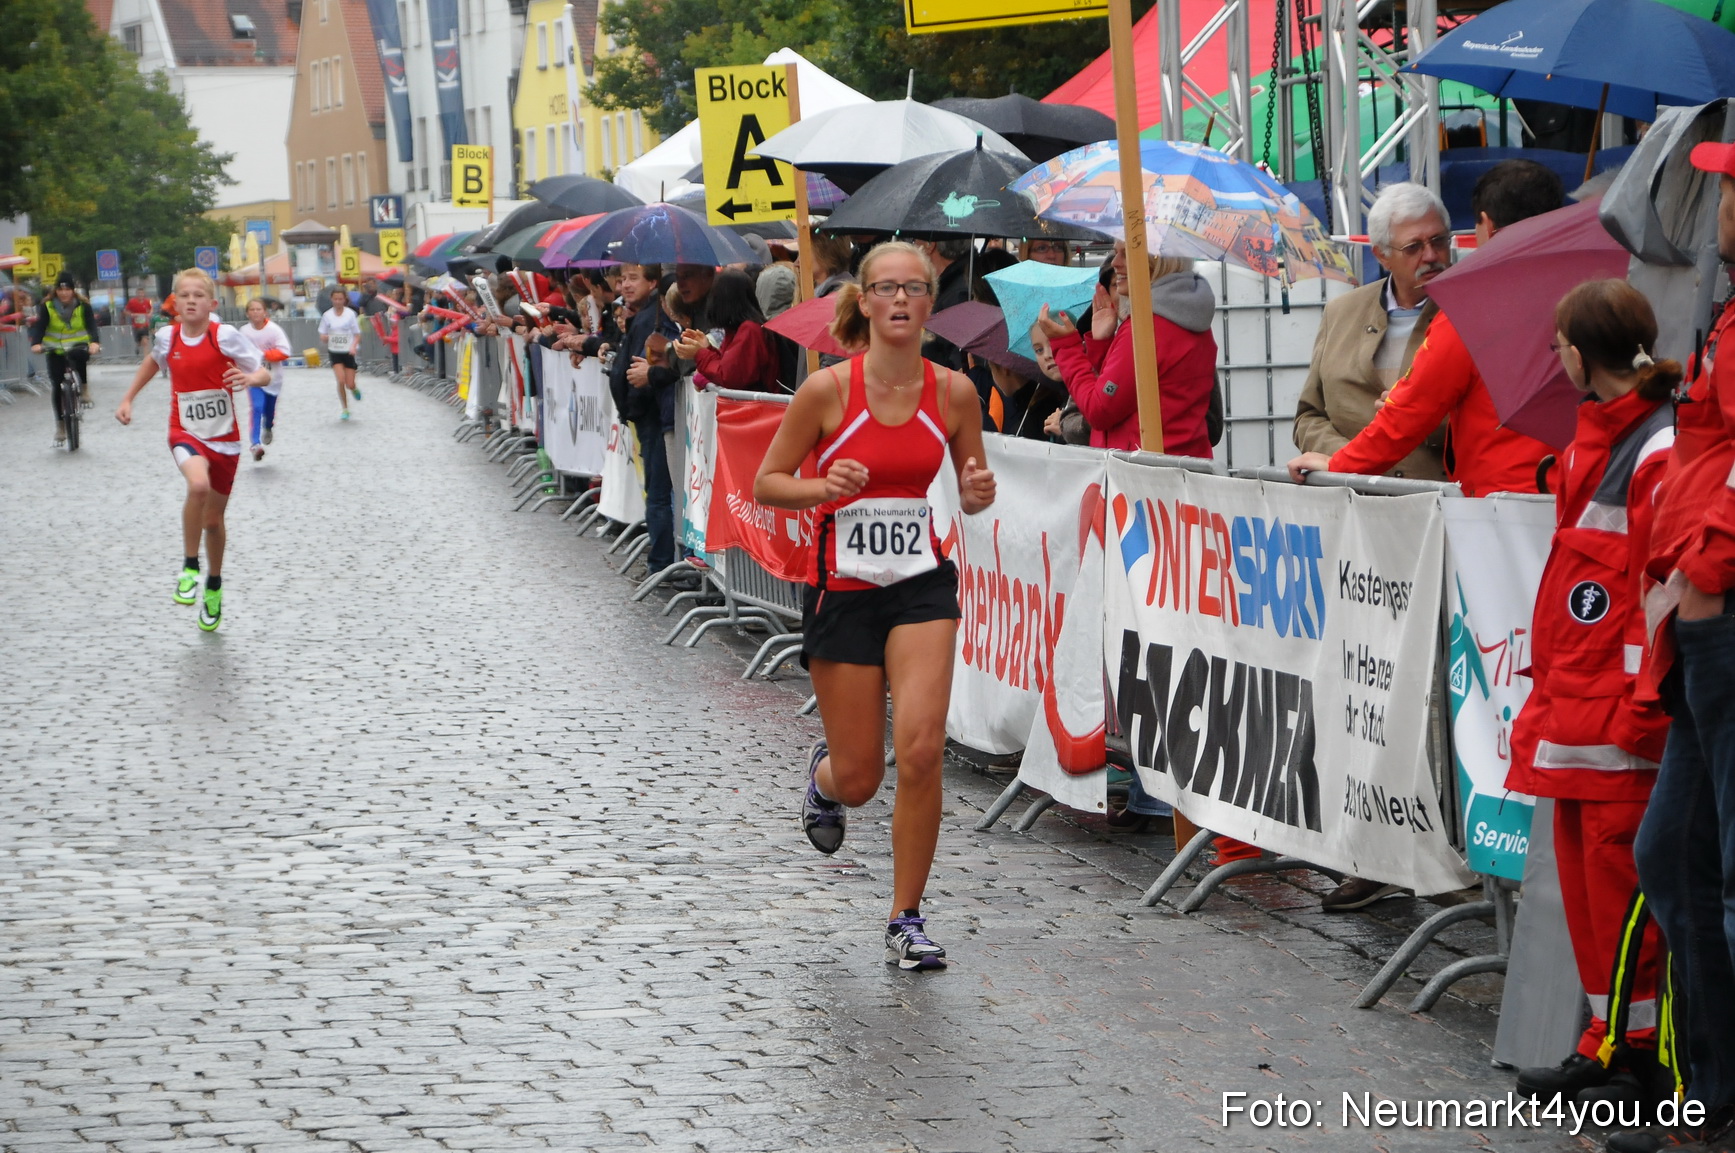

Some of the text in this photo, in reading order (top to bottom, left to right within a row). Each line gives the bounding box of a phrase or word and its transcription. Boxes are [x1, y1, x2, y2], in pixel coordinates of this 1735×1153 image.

[708, 71, 788, 102] Block
[457, 147, 489, 160] Block
[726, 113, 784, 190] A
[463, 164, 483, 194] B
[386, 240, 399, 259] C
[46, 262, 57, 278] D
[345, 256, 356, 271] D
[100, 269, 118, 279] TAXI
[185, 399, 227, 421] 4050
[837, 507, 916, 518] PARTL Neumarkt
[847, 521, 922, 556] 4062
[1146, 497, 1326, 641] INTERSPORT
